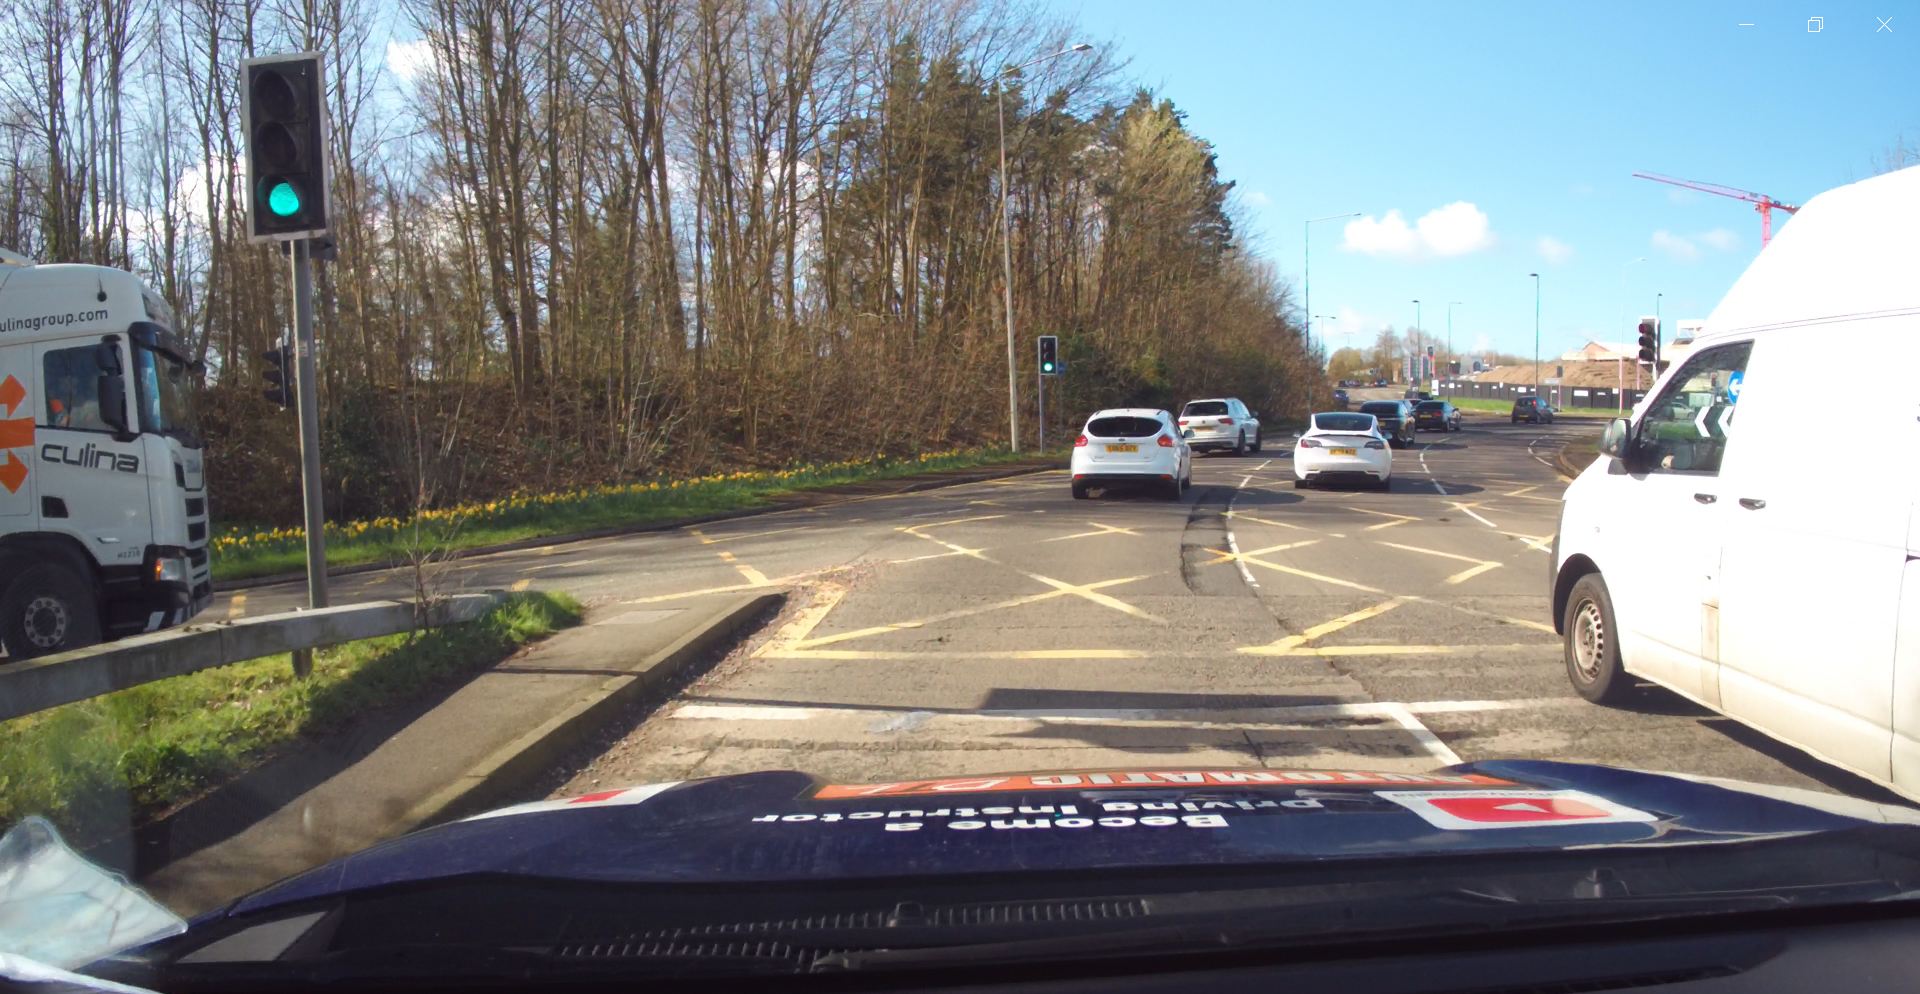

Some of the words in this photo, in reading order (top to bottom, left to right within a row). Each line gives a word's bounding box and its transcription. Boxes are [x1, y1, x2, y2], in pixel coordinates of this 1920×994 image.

[41, 443, 139, 473] culina
[751, 805, 1079, 823] Instructor
[1103, 799, 1325, 812] Driving
[885, 822, 924, 832] a
[948, 814, 1230, 831] Become
